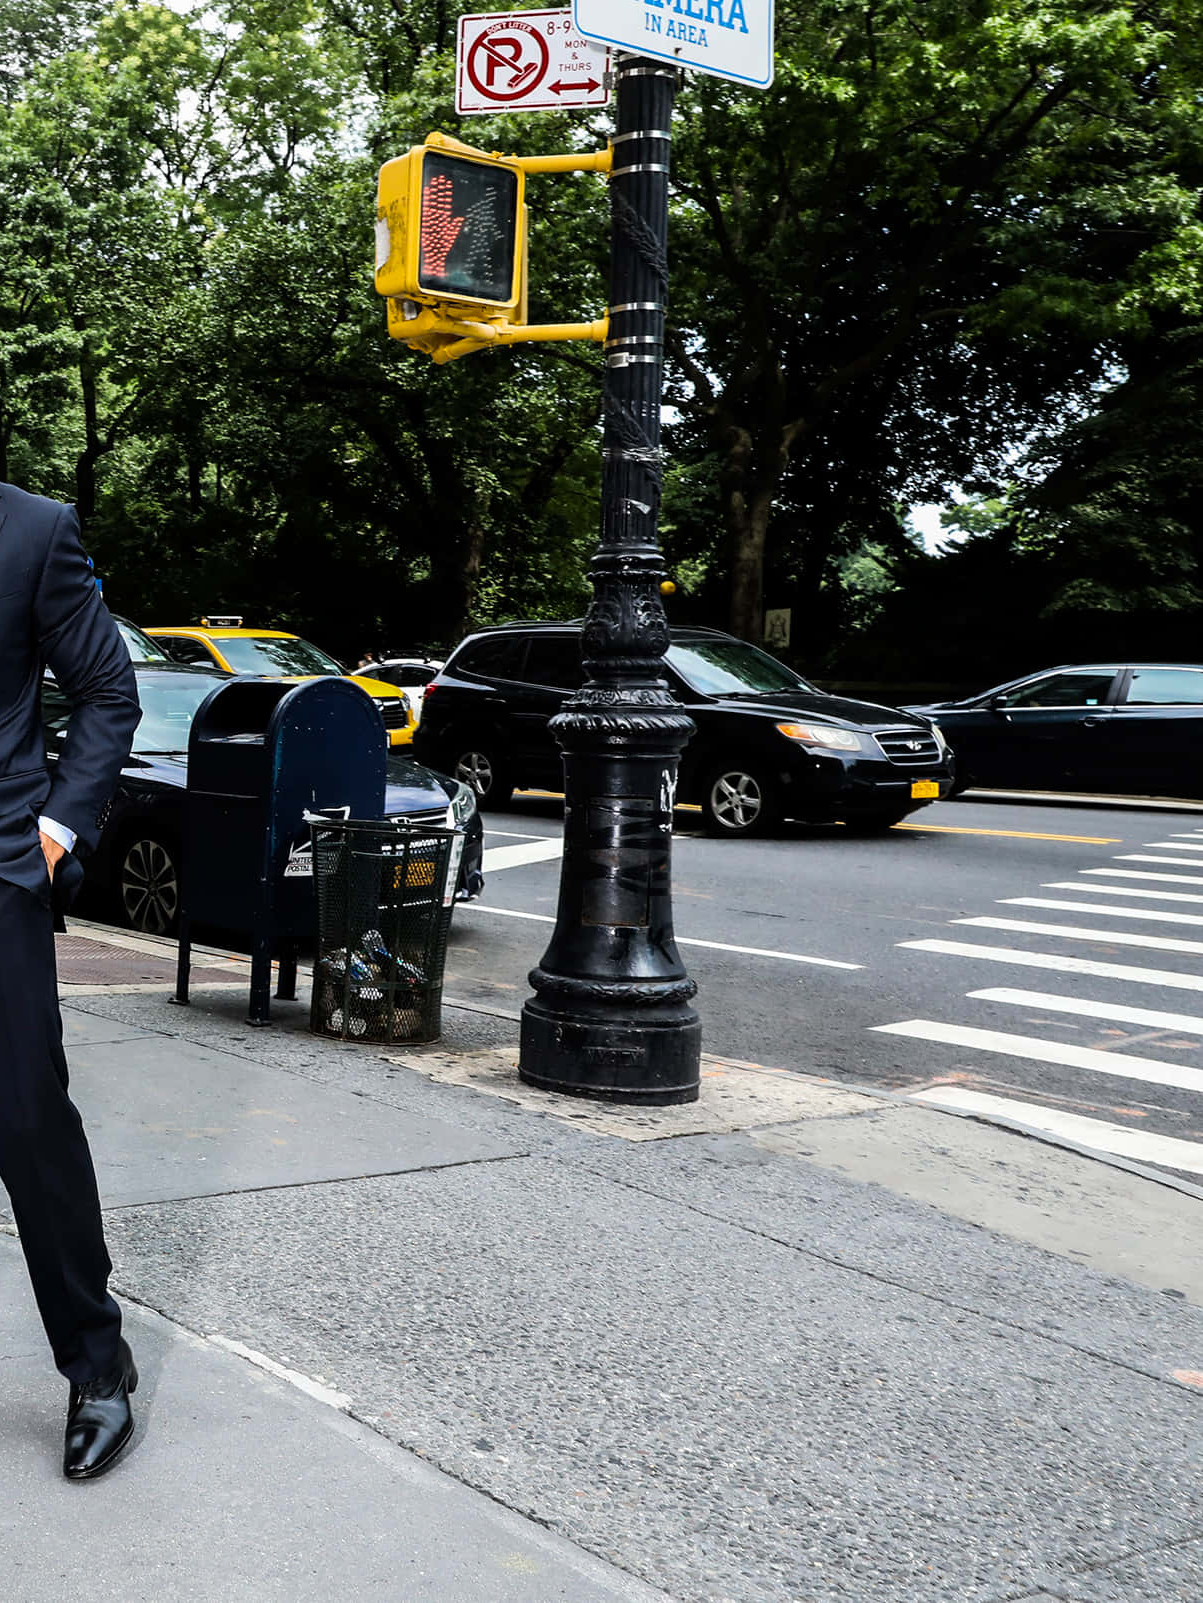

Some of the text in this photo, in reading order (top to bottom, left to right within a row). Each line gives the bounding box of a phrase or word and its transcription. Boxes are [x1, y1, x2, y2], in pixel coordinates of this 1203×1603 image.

[644, 0, 749, 34] ERA
[546, 20, 574, 36] 8-9
[645, 12, 709, 47] IN AREA
[564, 39, 588, 49] MON
[571, 51, 579, 60] &
[558, 62, 592, 72] THURS
